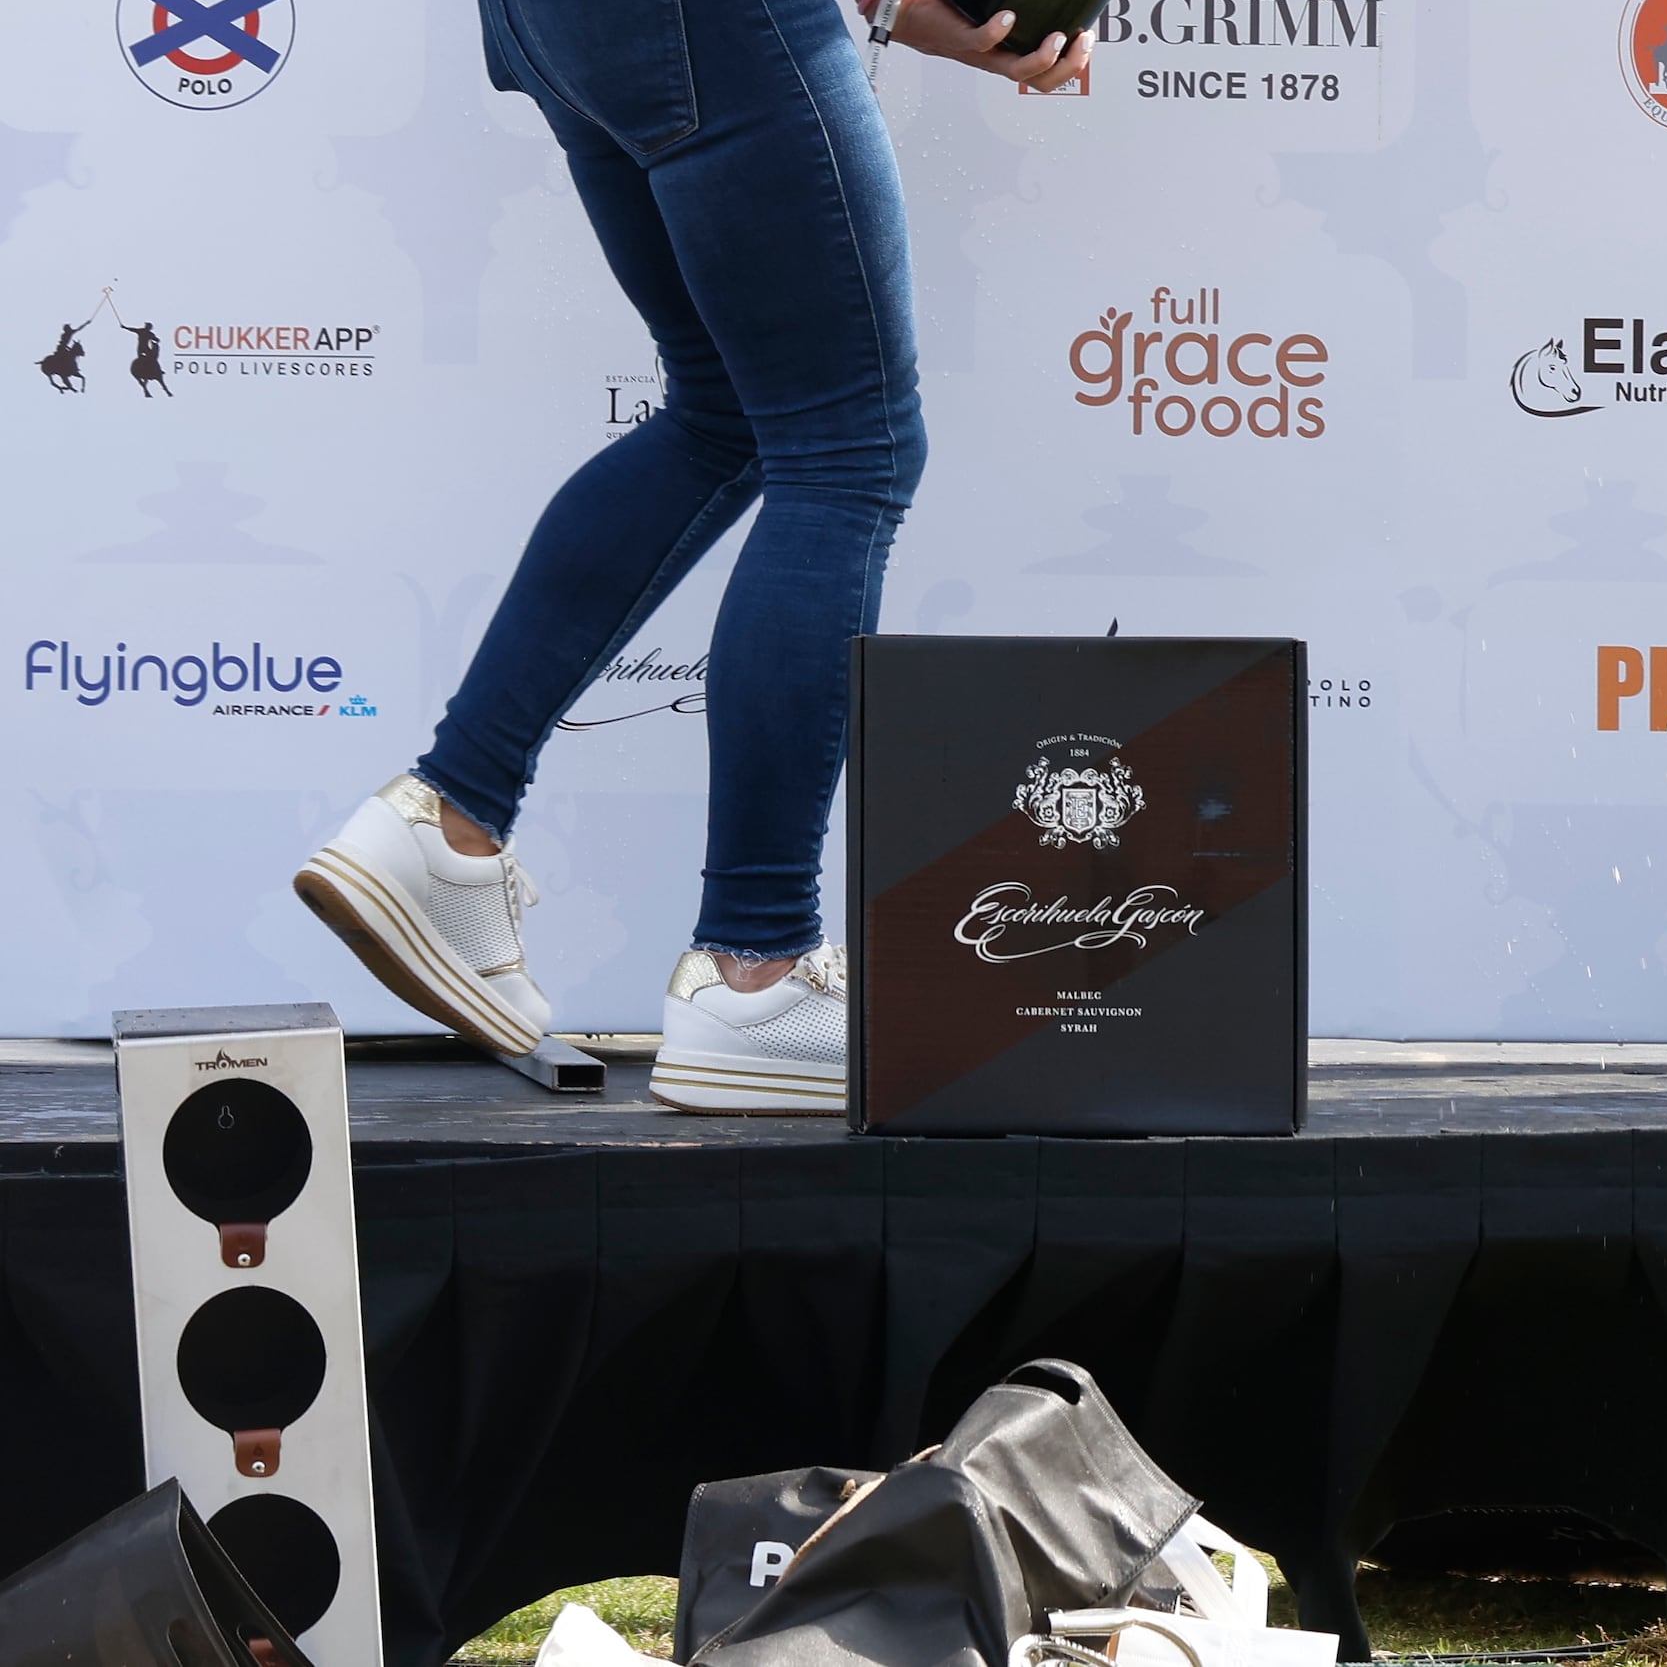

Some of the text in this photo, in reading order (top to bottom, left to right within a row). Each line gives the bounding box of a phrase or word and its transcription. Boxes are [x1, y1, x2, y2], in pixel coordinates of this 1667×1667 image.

[178, 77, 233, 96] POLO
[1137, 69, 1340, 102] SINCE 1878
[1150, 286, 1221, 327] full
[173, 361, 373, 377] POLO LIVESCORES
[1068, 316, 1330, 408] grace
[603, 374, 656, 384] ESTANCIA
[1126, 377, 1327, 439] foods
[212, 704, 380, 718] AIRFRANCE KLM
[1036, 736, 1068, 750] ORIGEN
[1069, 734, 1076, 742] &
[1069, 748, 1090, 757] 1884
[1056, 991, 1102, 1000] MALBEC
[1015, 1007, 1142, 1017] CABERNET SAUVIGNON
[1060, 1023, 1098, 1033] SYRAH
[194, 1046, 268, 1071] TROMEN
